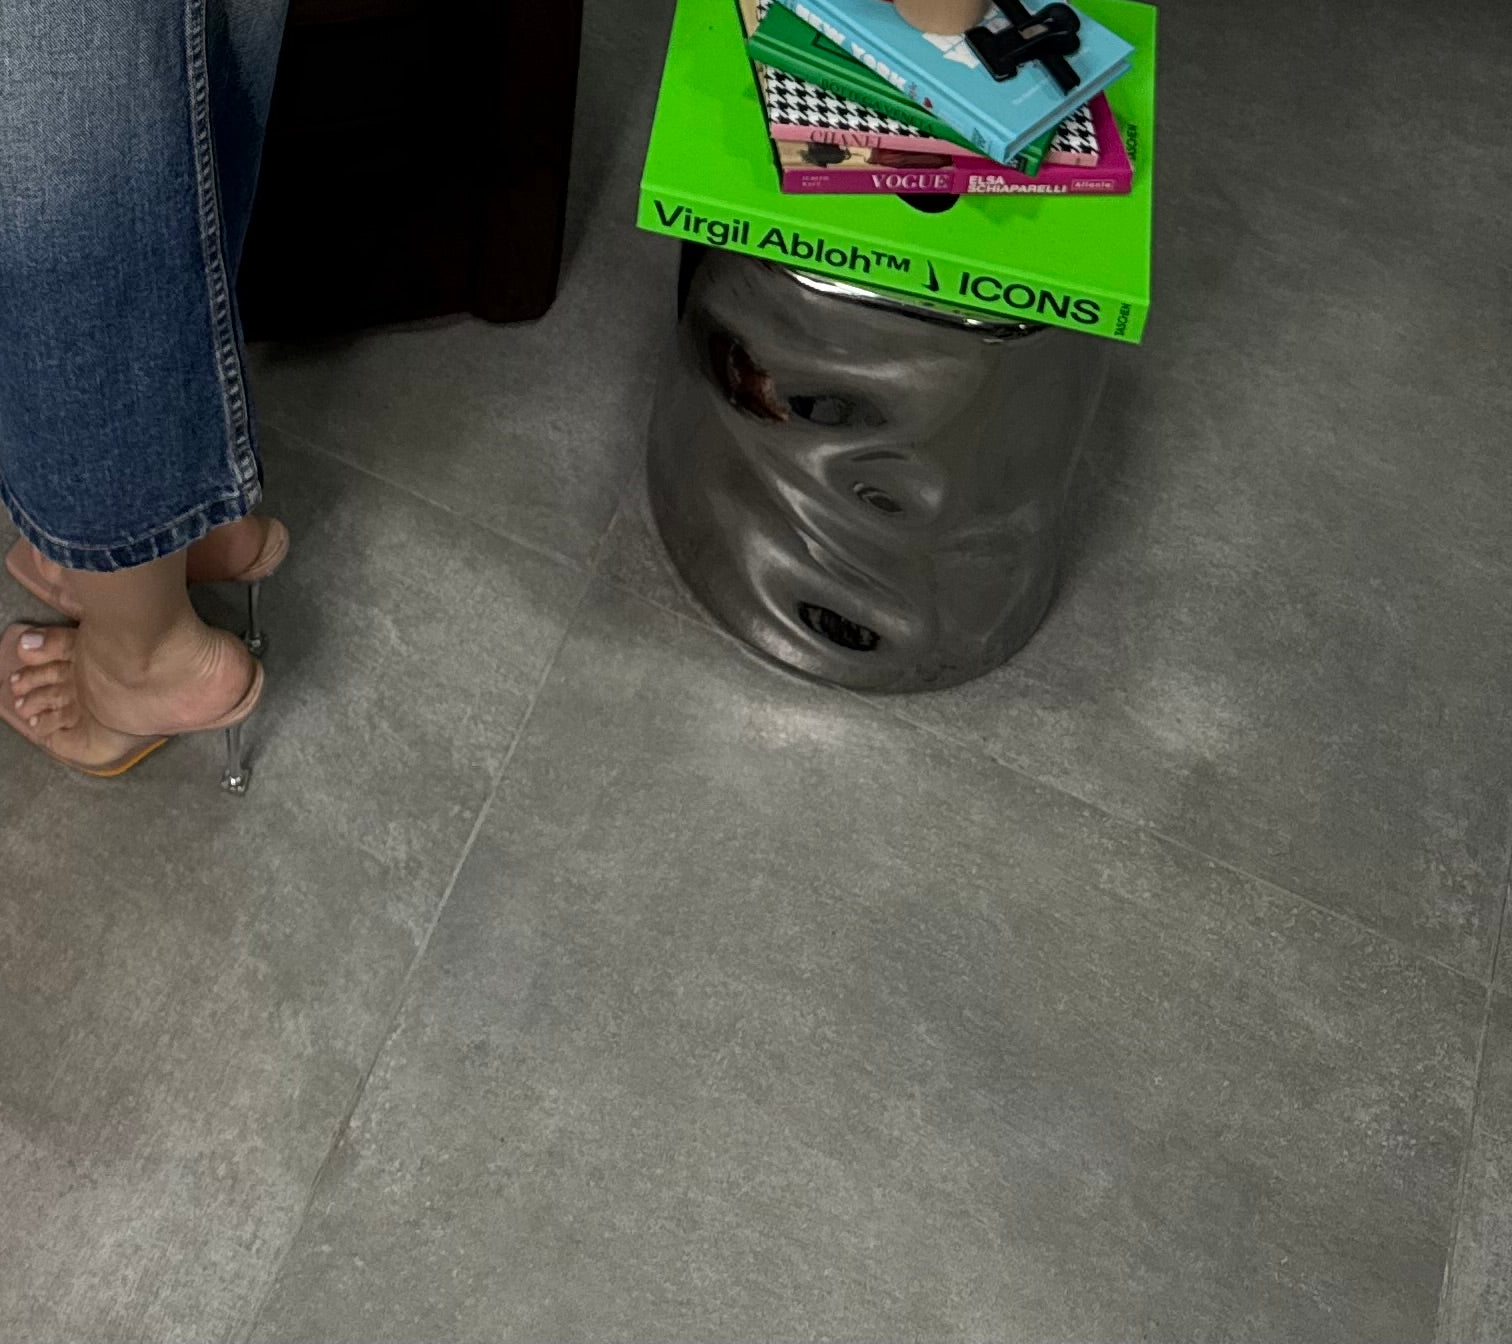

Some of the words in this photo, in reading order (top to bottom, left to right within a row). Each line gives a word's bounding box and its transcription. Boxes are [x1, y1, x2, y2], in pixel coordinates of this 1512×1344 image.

[871, 173, 949, 190] VOGUE
[968, 175, 1005, 185] ELSA
[967, 184, 1068, 194] SCHIAPARELLI
[653, 199, 750, 246] Virgil
[958, 270, 1101, 327] ICONS
